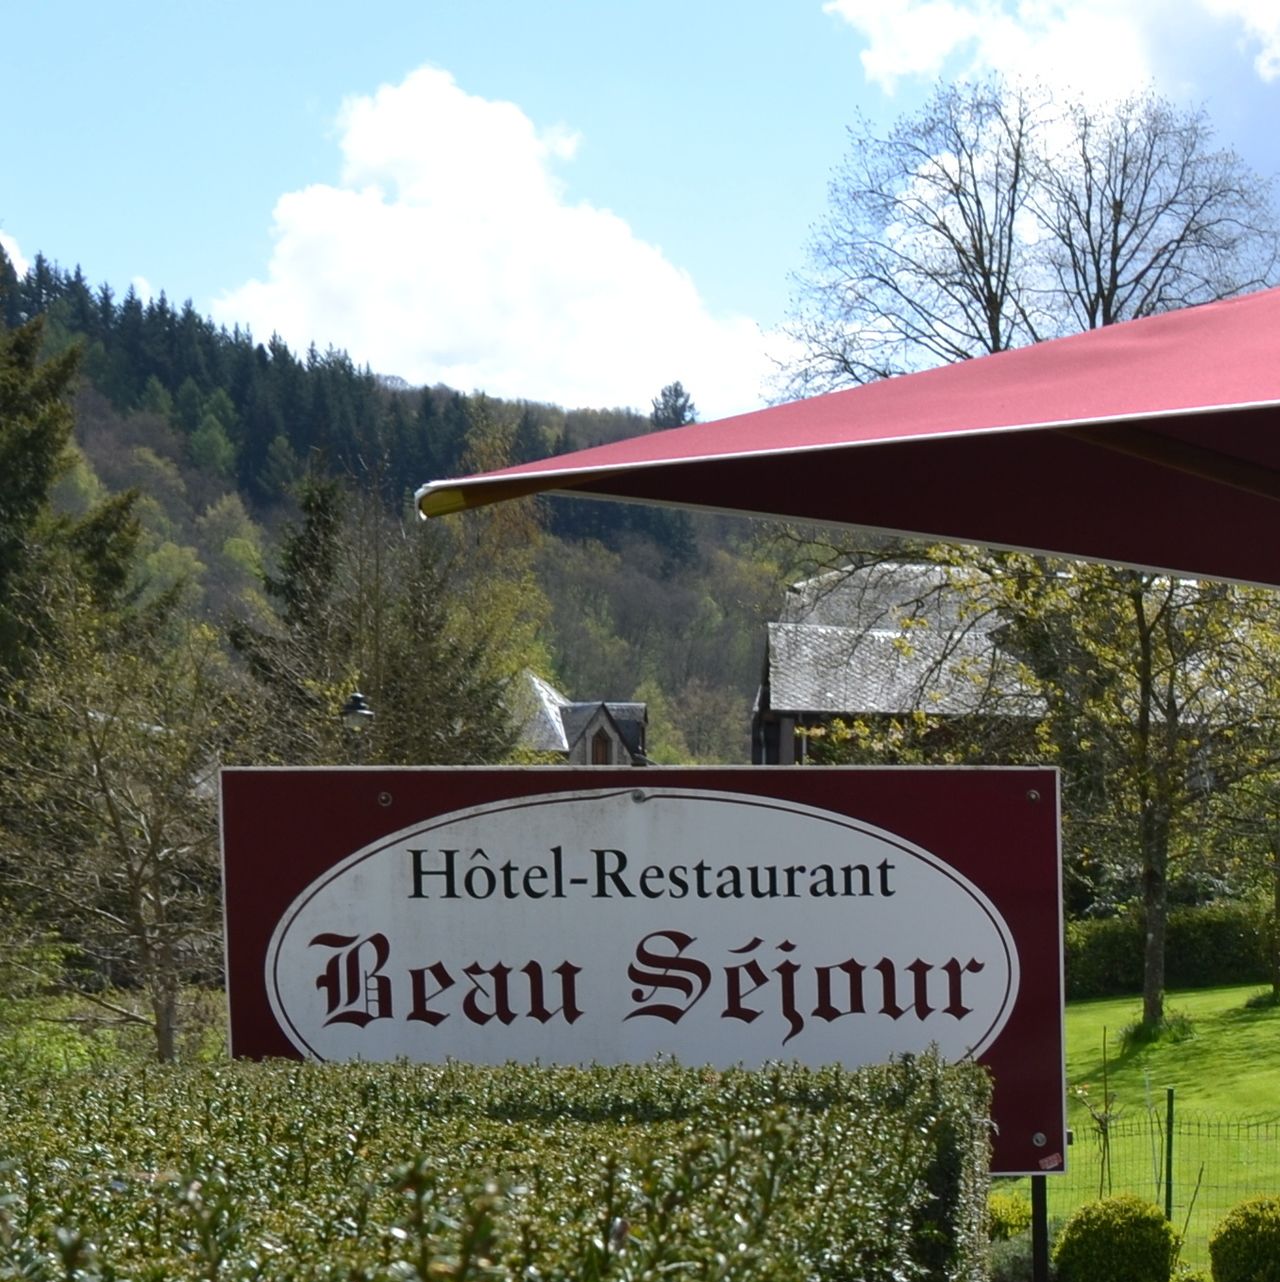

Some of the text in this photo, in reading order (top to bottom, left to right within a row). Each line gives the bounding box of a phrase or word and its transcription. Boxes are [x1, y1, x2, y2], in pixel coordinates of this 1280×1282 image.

[406, 845, 897, 900] Hôtel-Restaurant
[308, 930, 986, 1047] Beau Séjour
